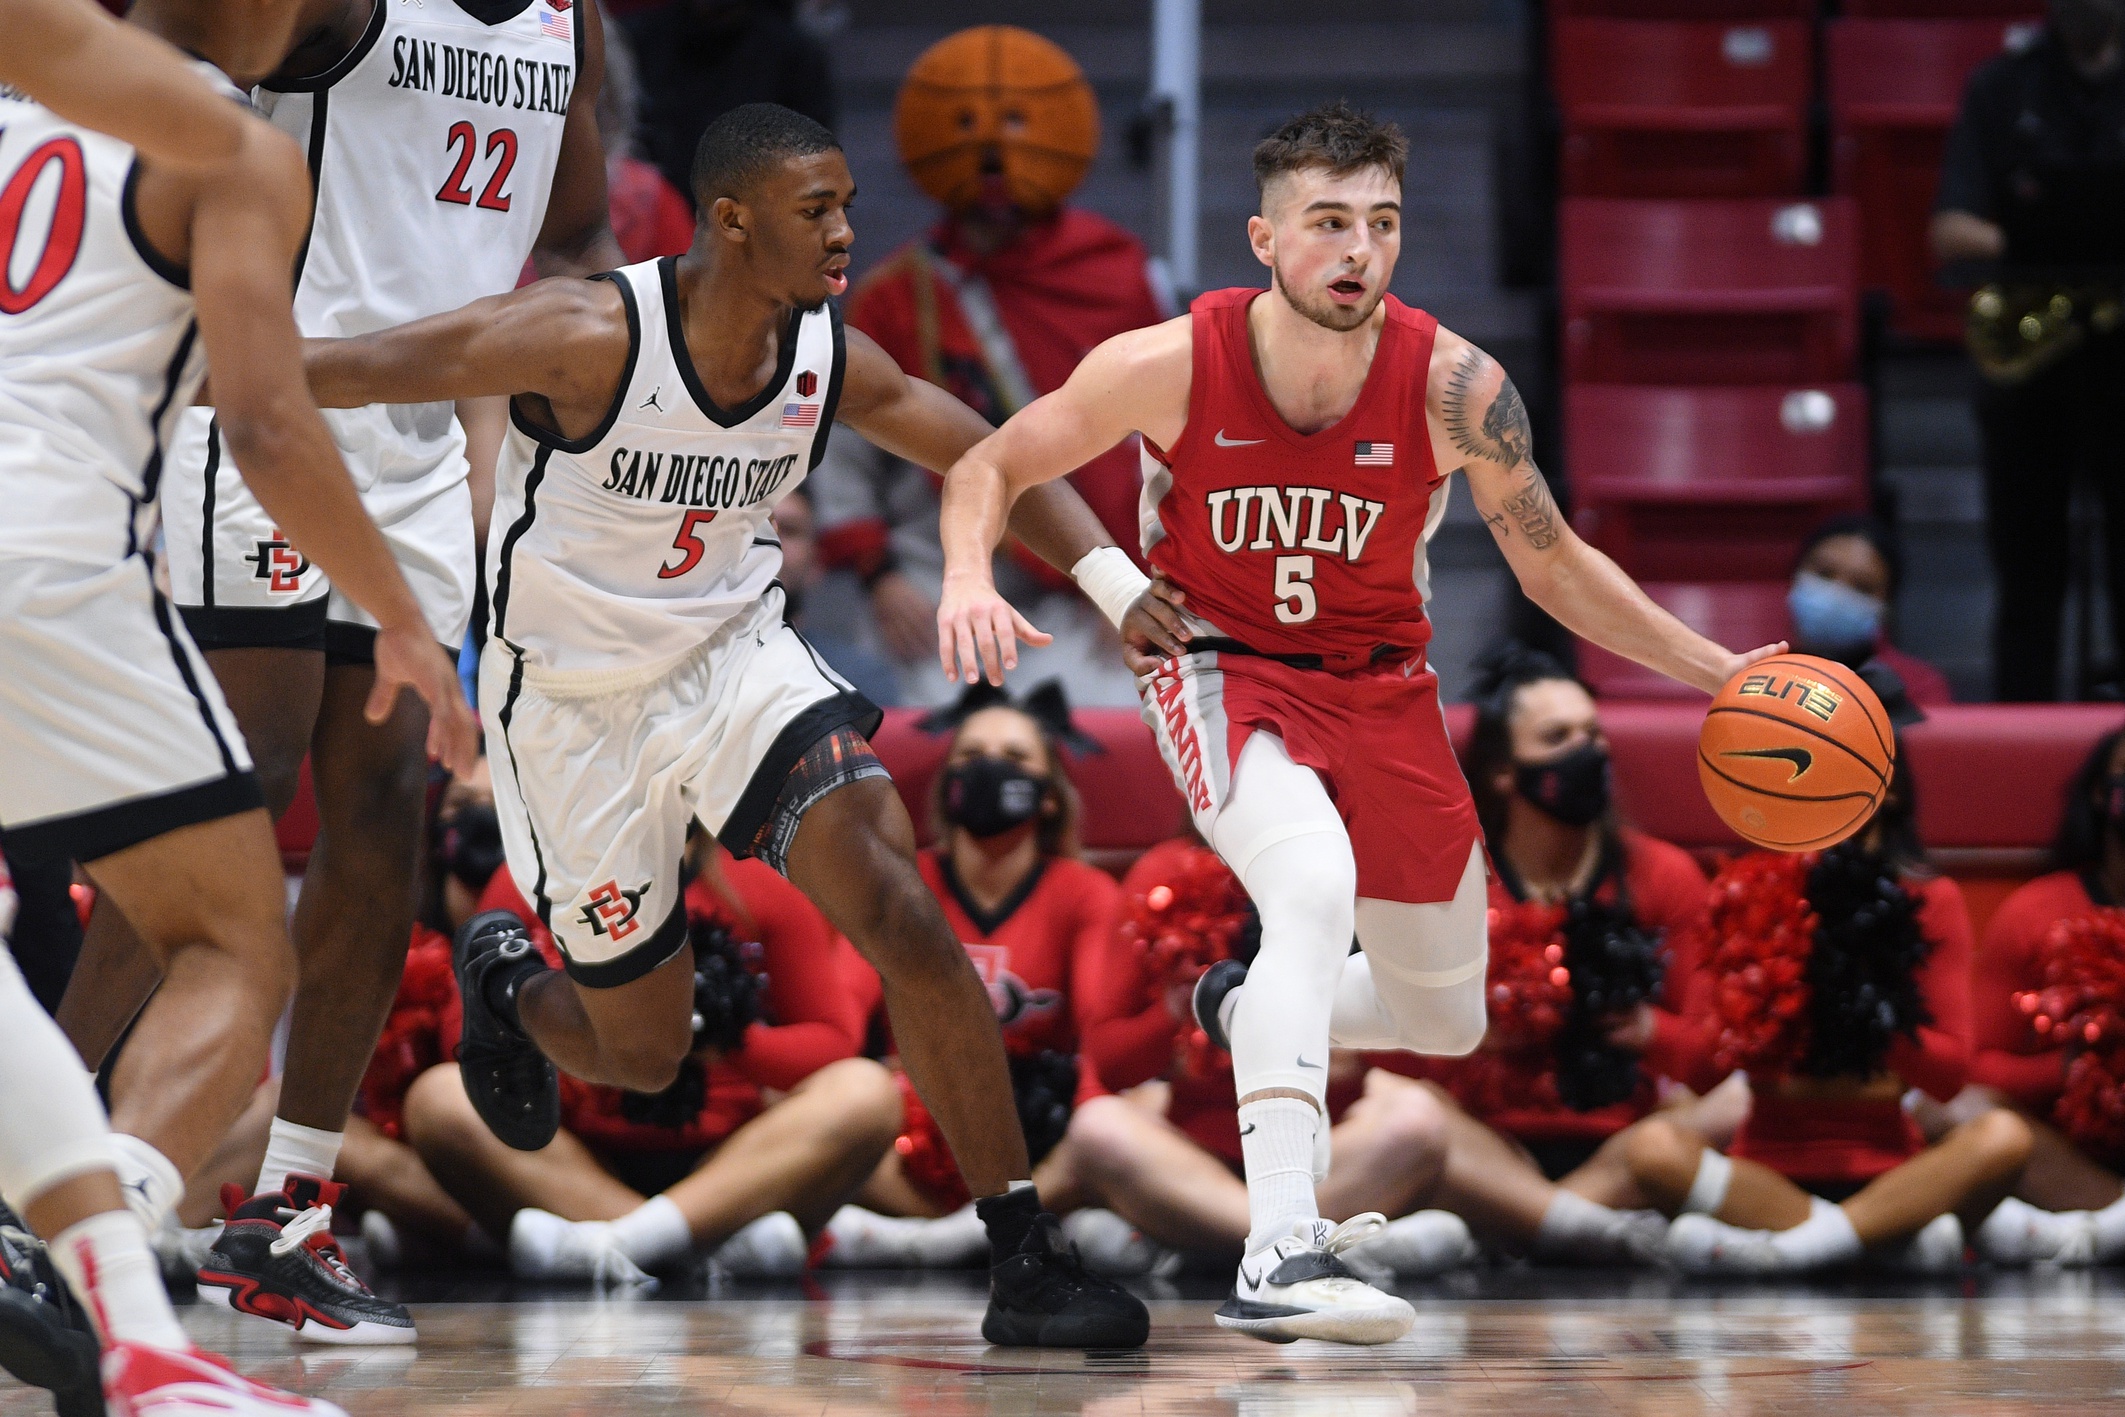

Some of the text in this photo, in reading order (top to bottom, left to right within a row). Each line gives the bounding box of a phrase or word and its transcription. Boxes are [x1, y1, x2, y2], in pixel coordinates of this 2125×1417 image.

[388, 34, 571, 116] SAN DIEGO STATE
[435, 120, 518, 212] 22
[0, 122, 88, 315] 0
[602, 447, 799, 509] SAN DIEGO STATE
[657, 508, 719, 579] 5
[1207, 485, 1385, 562] UNLV
[1273, 554, 1318, 625] 5
[1737, 674, 1840, 723] ELITE
